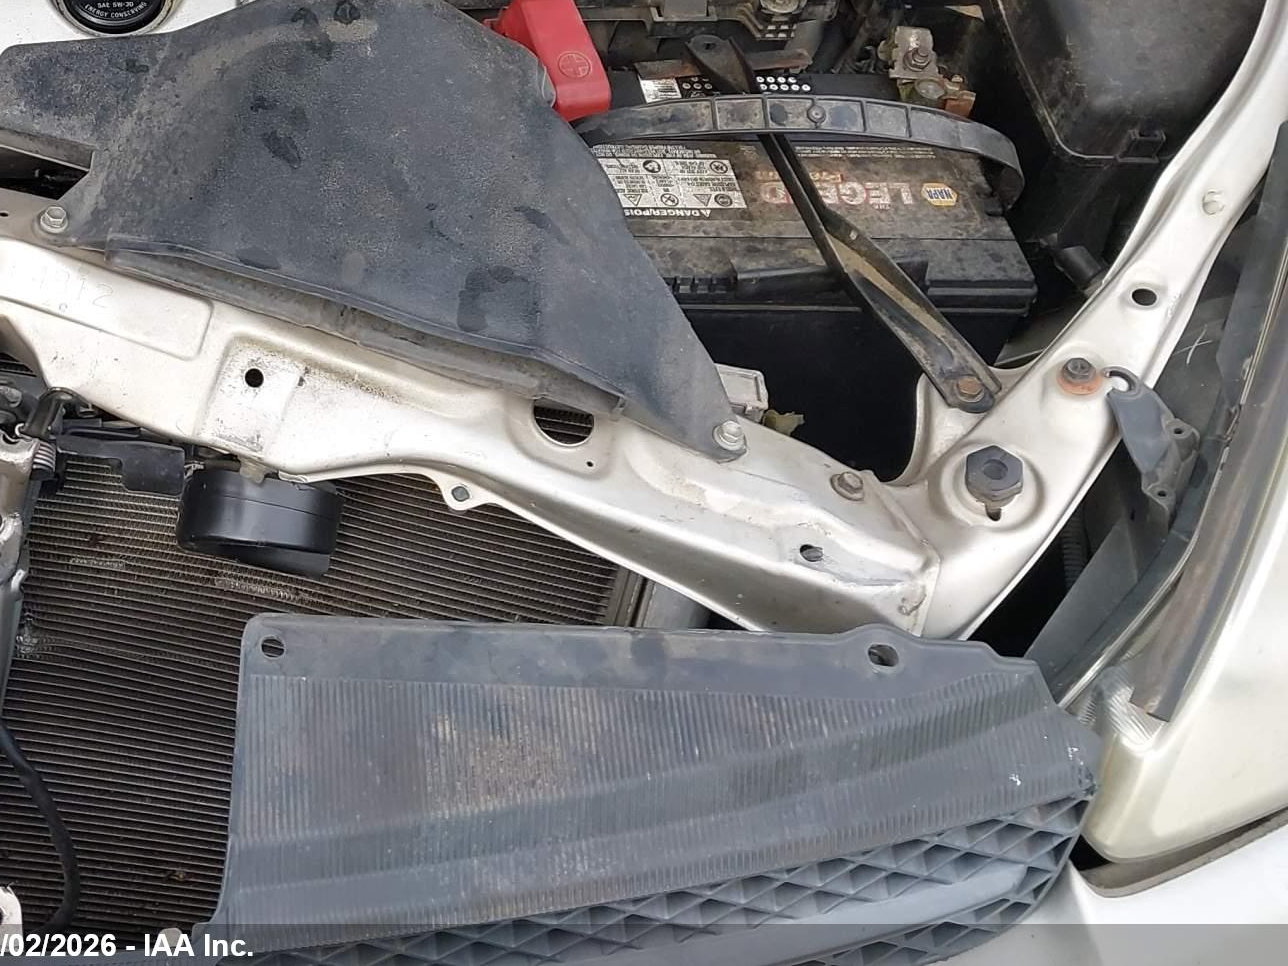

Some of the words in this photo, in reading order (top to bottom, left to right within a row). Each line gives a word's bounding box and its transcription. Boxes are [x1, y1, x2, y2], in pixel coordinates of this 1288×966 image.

[85, 4, 109, 17] ENERGY
[760, 182, 914, 207] LEGED
[925, 187, 953, 199] NAPA
